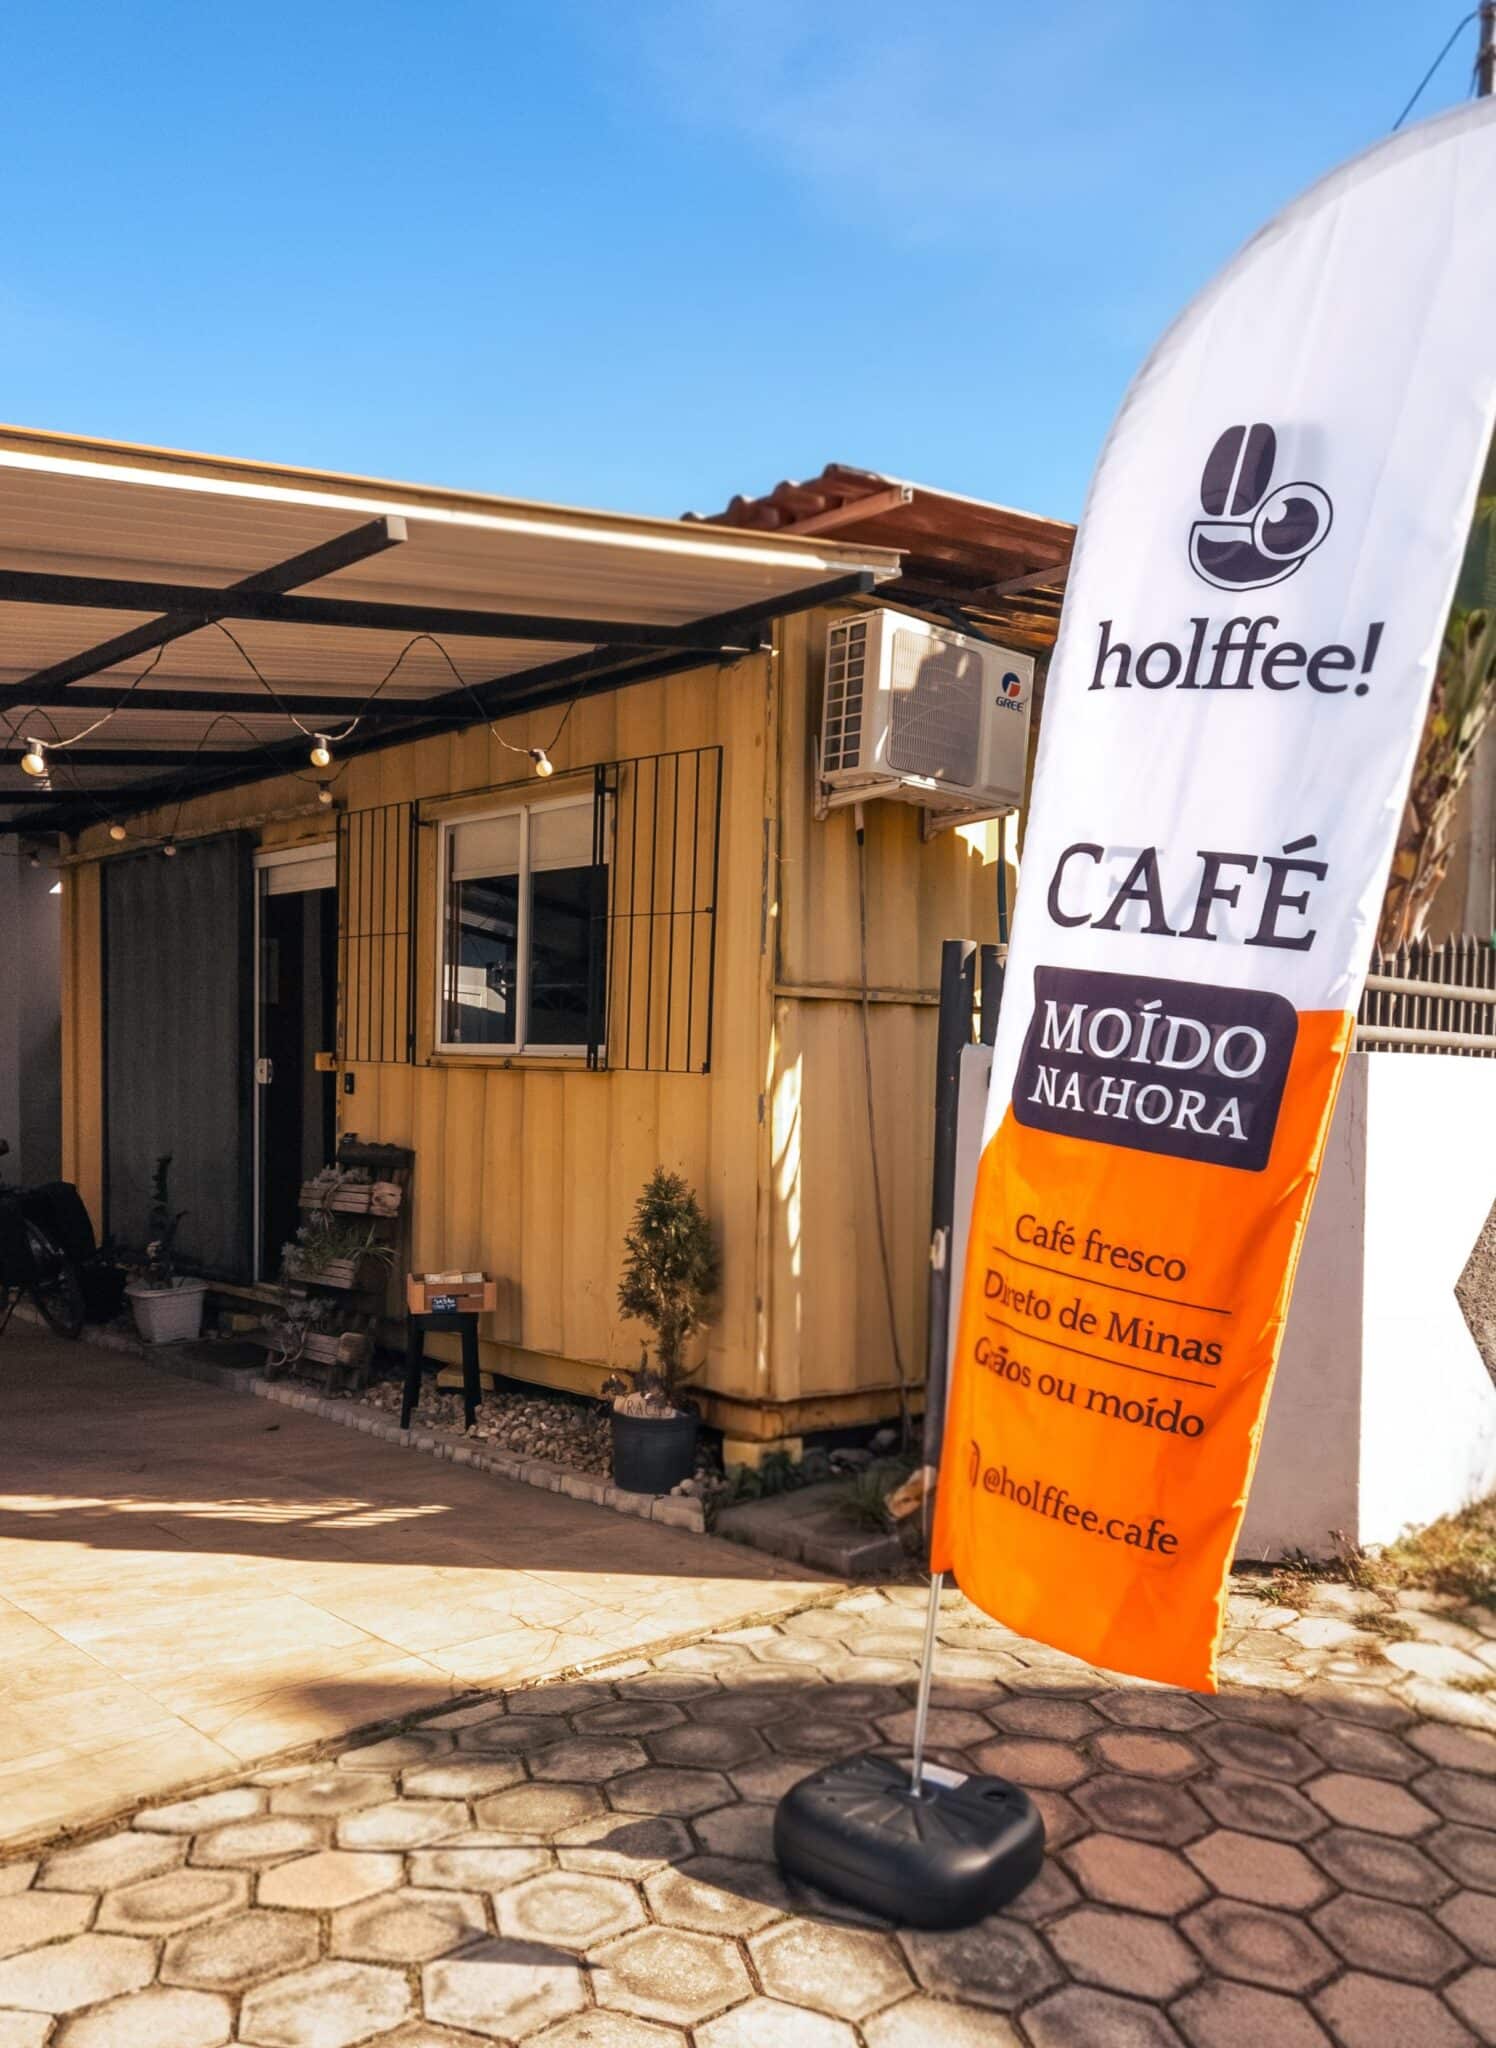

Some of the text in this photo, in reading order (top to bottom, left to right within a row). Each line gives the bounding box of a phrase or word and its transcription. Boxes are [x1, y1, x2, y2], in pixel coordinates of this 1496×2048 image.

[1088, 615, 1385, 697] holffee!
[996, 696, 1024, 712] GREE
[1047, 834, 1329, 952] CAFÉ
[1040, 1000, 1267, 1079] MOÍDO
[1027, 1065, 1248, 1141] NA HORA
[1015, 1214, 1187, 1282] Café fresco
[1059, 1298, 1097, 1334] de
[1104, 1311, 1224, 1366] Minas
[1038, 1373, 1076, 1404] ou
[1084, 1388, 1205, 1438] moído
[983, 1465, 1179, 1555] @holffee.cafe
